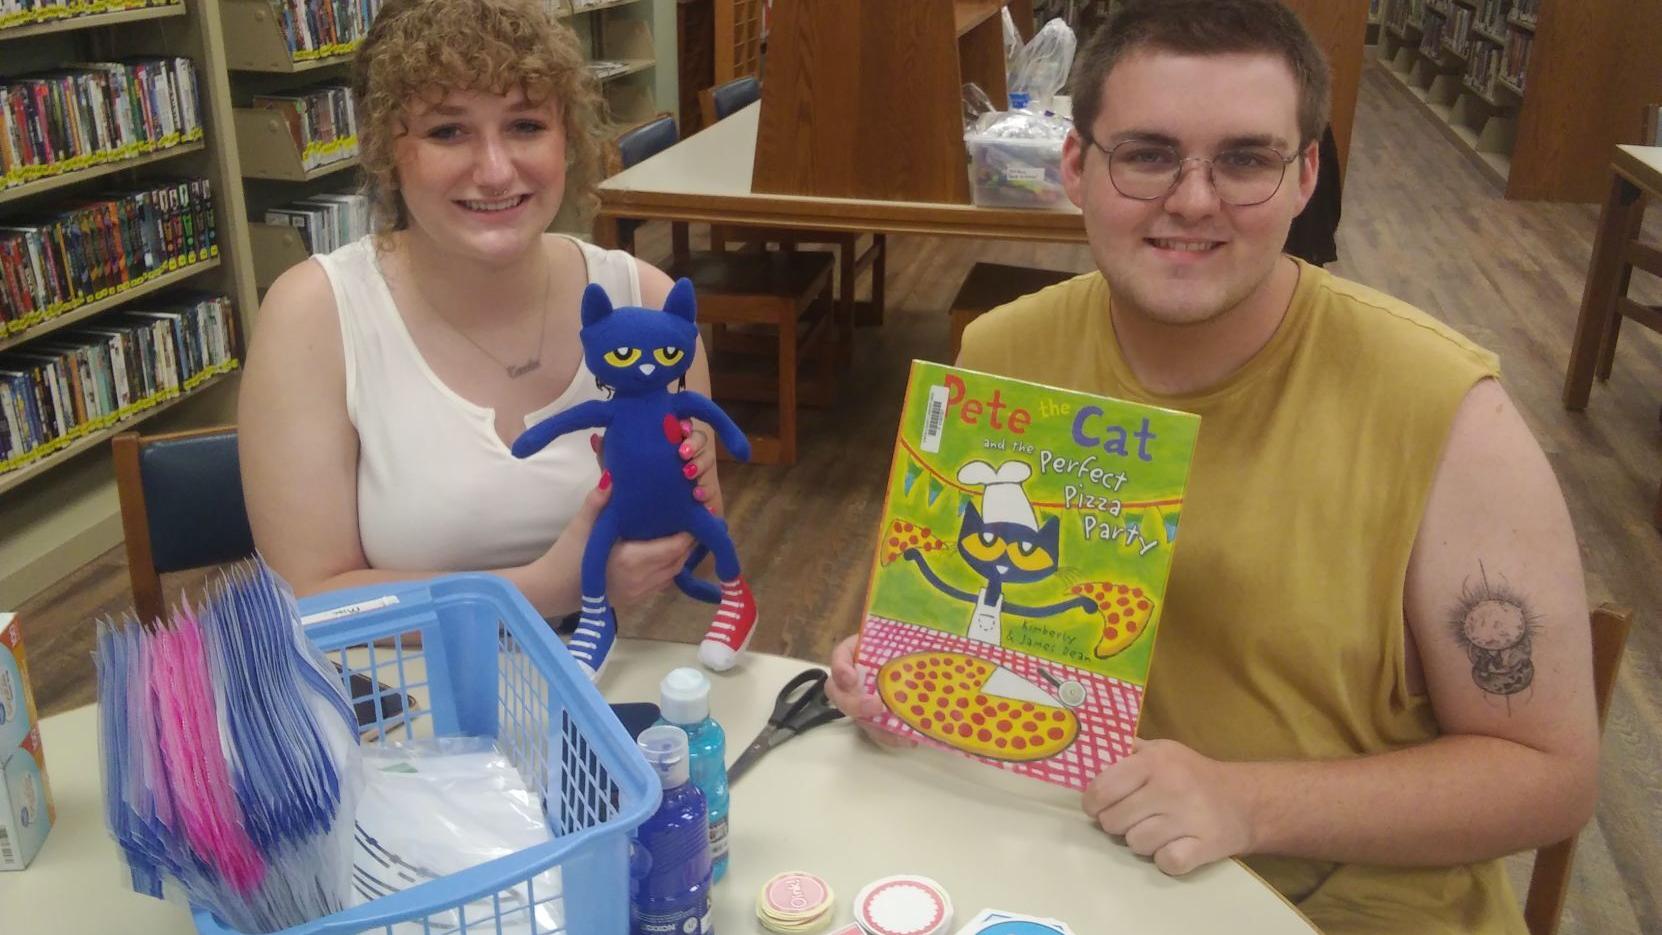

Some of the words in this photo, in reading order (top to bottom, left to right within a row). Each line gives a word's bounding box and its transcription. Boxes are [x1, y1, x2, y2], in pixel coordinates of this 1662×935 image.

[944, 374, 1032, 434] Pete
[1040, 400, 1071, 418] the
[1072, 405, 1157, 462] Cat
[984, 438, 1006, 451] and
[1013, 441, 1035, 454] the
[1040, 450, 1128, 492] Perfect
[1064, 483, 1122, 517] Pizza
[1084, 515, 1158, 556] Party
[1019, 634, 1056, 653] James
[1022, 621, 1077, 644] Kimberly
